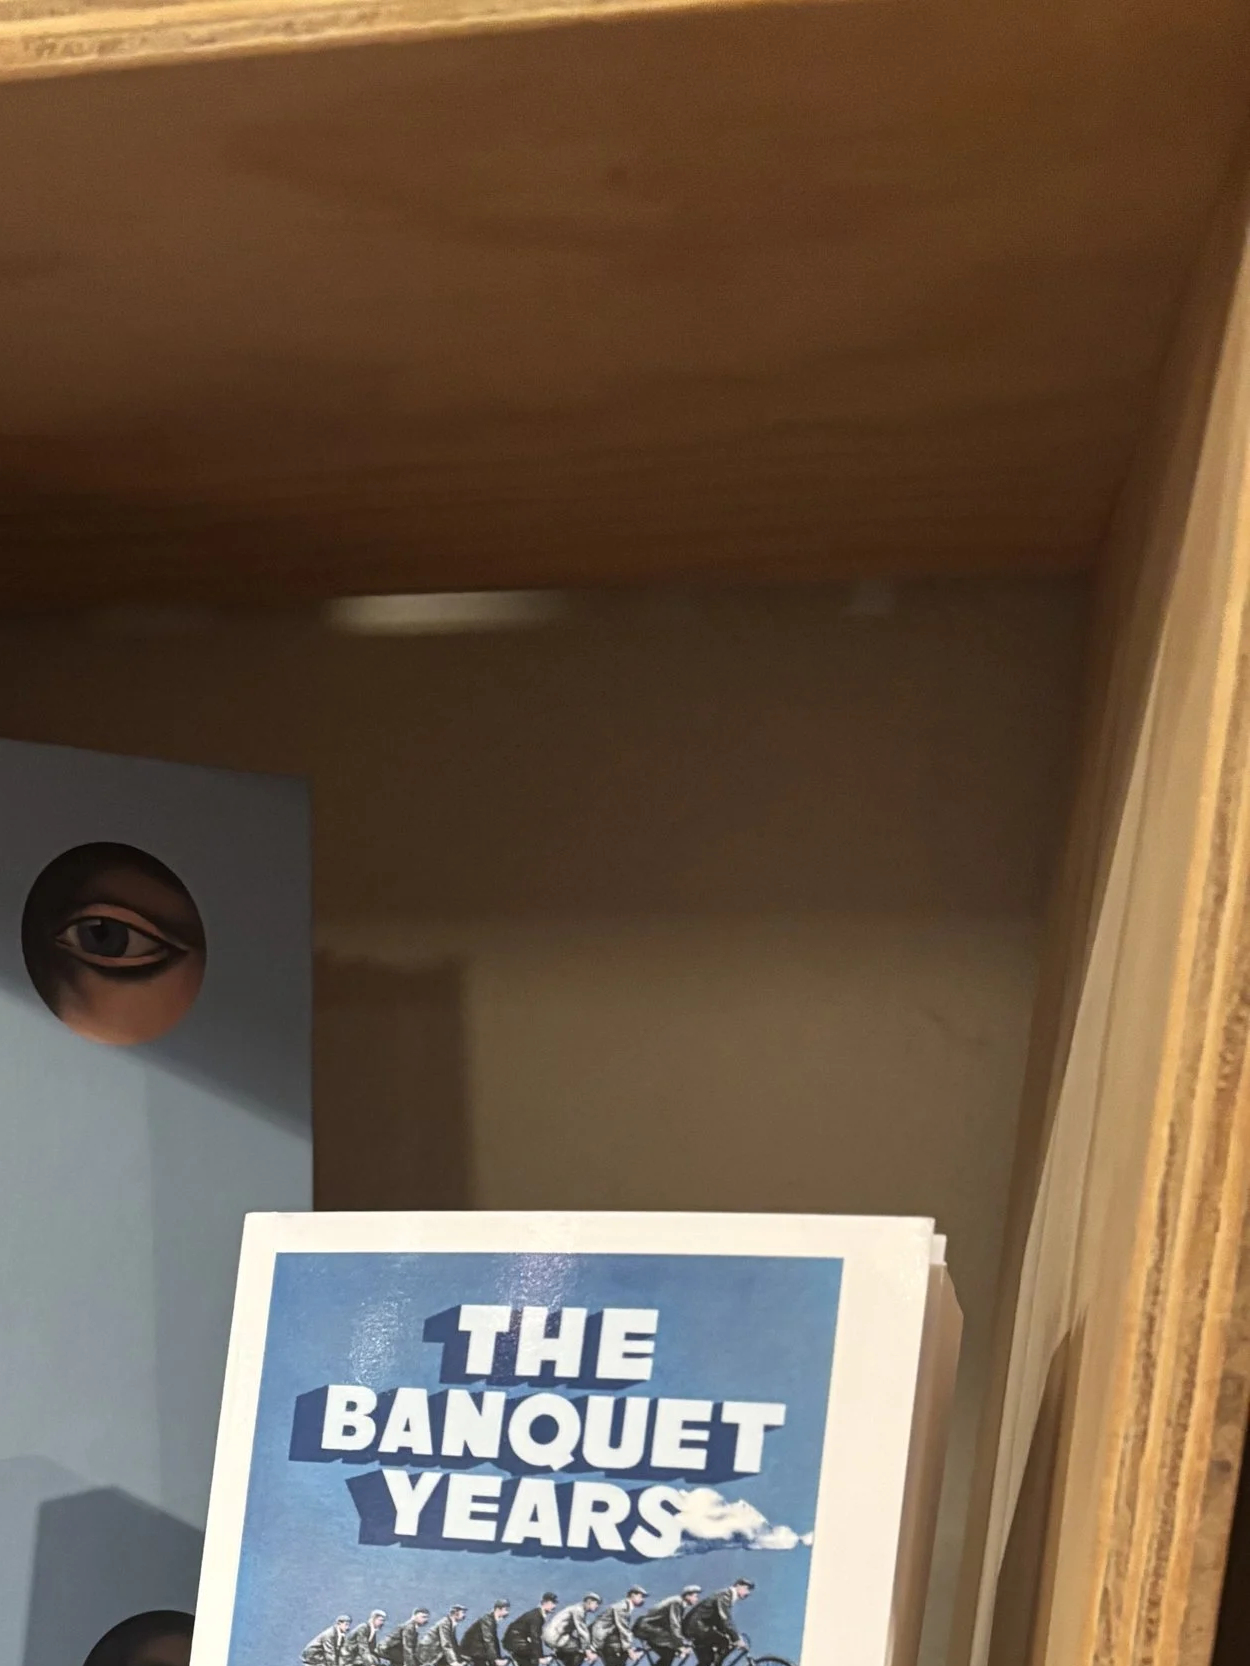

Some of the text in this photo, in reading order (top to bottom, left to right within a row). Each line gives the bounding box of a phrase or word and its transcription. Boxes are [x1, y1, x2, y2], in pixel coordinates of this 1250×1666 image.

[458, 1304, 660, 1381] THE
[321, 1384, 787, 1474] BANQUET
[381, 1468, 685, 1558] YEARS
